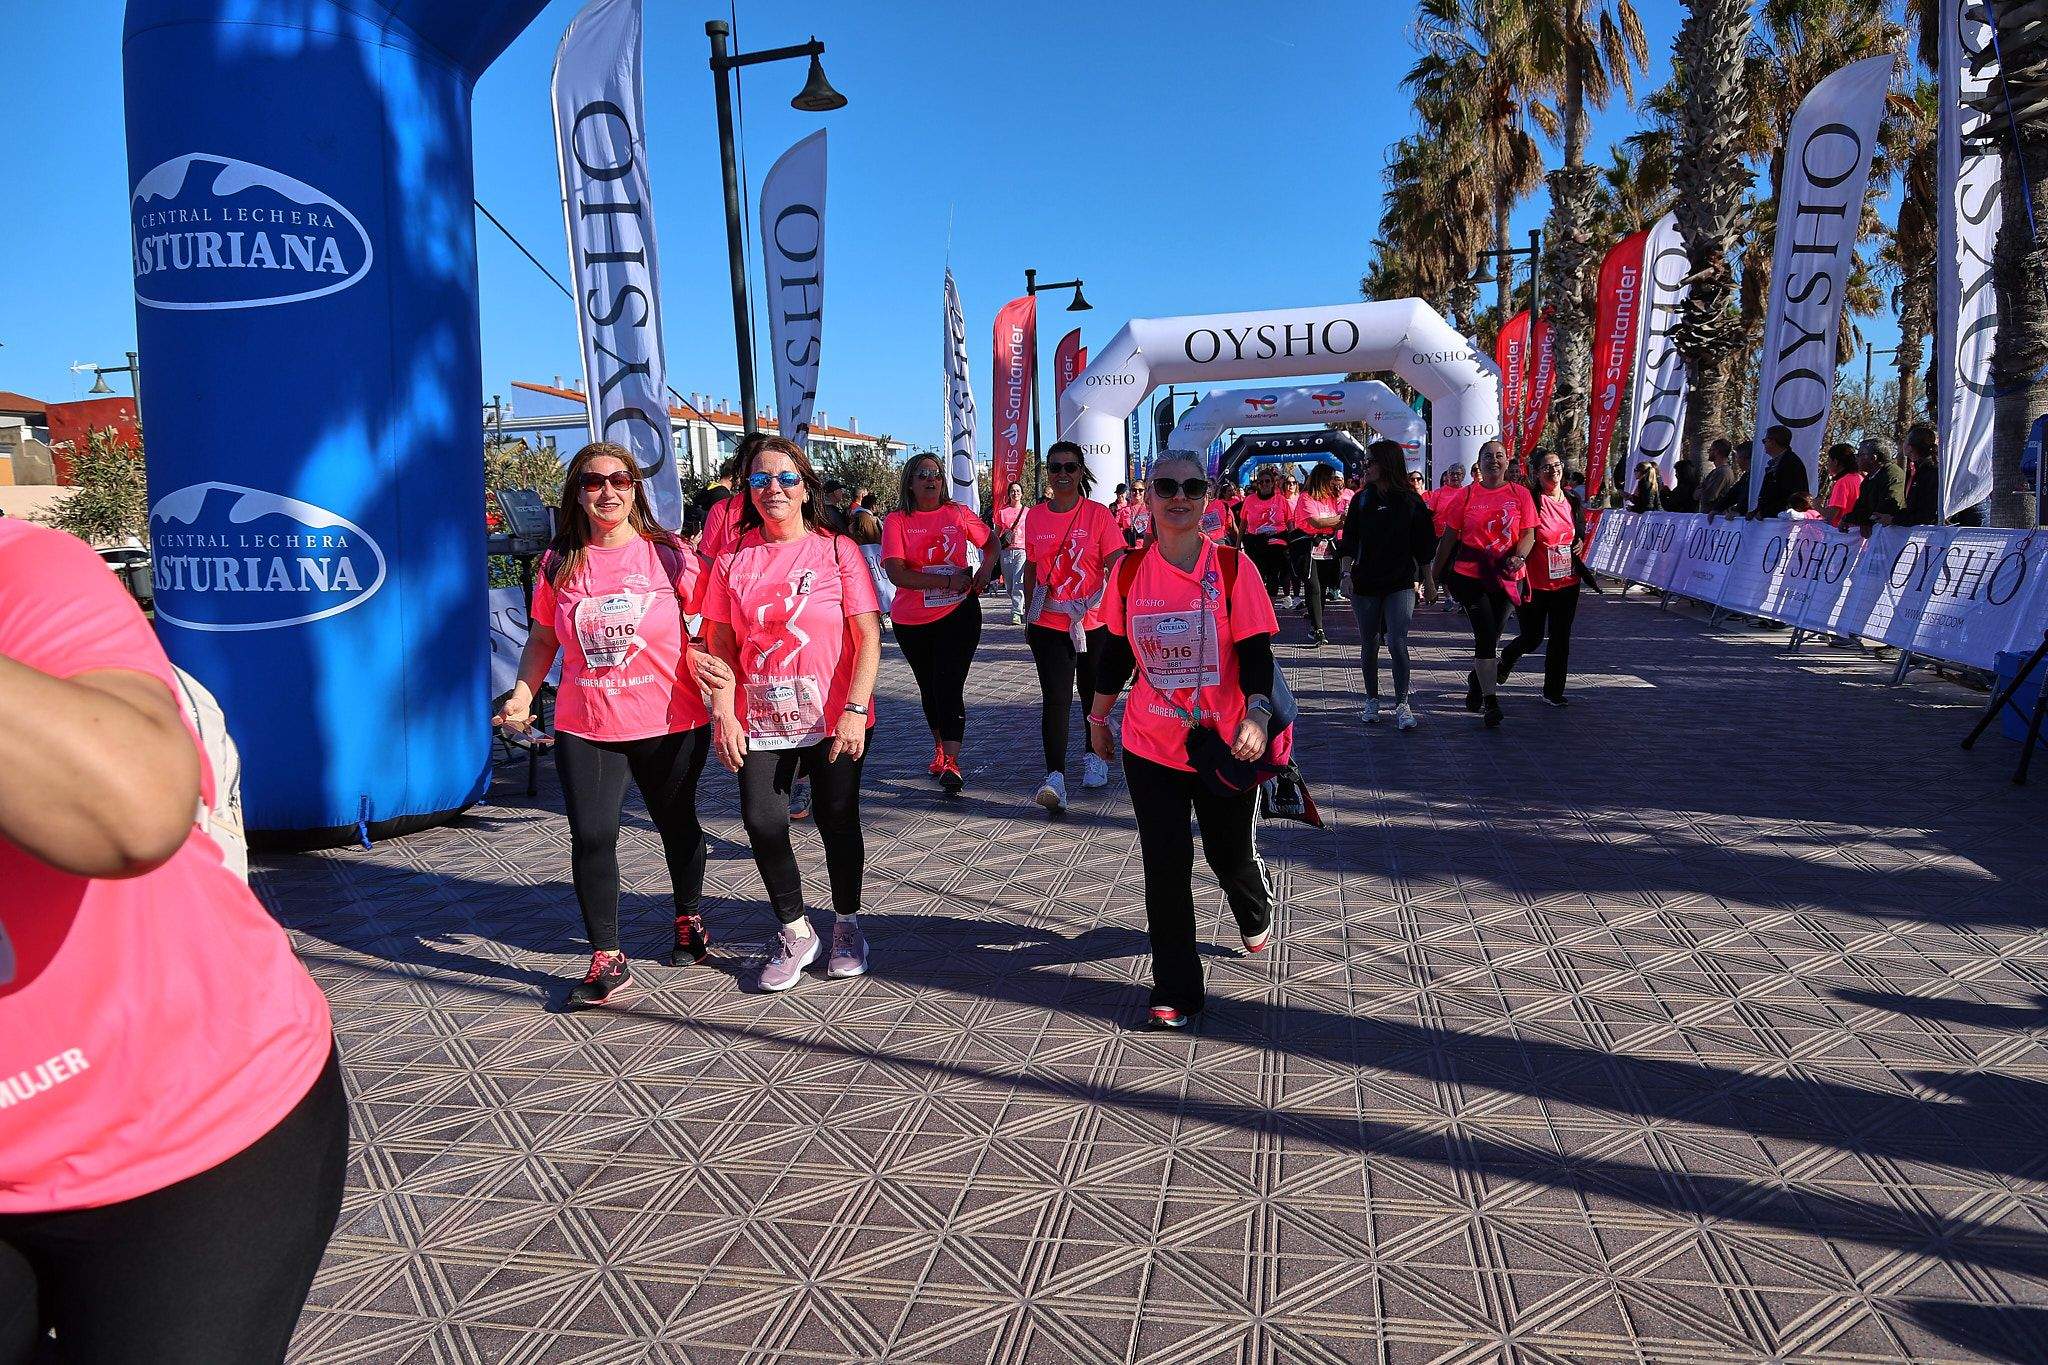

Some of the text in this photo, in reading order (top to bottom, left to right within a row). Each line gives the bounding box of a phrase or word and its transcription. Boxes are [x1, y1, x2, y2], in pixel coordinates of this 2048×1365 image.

[141, 207, 335, 229] CENTRAL LECHERA
[1771, 122, 1861, 429] OYSHO
[1606, 265, 1637, 381] Santander
[1184, 318, 1360, 364] OYSHO
[1412, 349, 1468, 366] OYSHO
[1006, 325, 1025, 421] Santander
[1085, 373, 1136, 387] OYSHO
[1506, 338, 1520, 416] Santander
[1443, 423, 1495, 438] OYSHO
[1081, 444, 1112, 456] SHO
[1256, 437, 1325, 449] VOLVO
[160, 533, 349, 548] CENTRAL LECHERA
[1634, 519, 1676, 554] OYSHO
[1688, 527, 1742, 566] OYSHO
[1762, 535, 1849, 584] OYSHO
[1889, 541, 2027, 606] OYSHO
[1135, 599, 1165, 607] OYSHO
[605, 623, 635, 638] 016
[1158, 624, 1188, 632] ASTURIANA
[1161, 646, 1192, 660] 016
[606, 679, 615, 687] DE
[617, 678, 627, 687] LA
[629, 675, 655, 686] MUJER
[771, 710, 801, 724] 016
[1148, 703, 1179, 719] CARRERA
